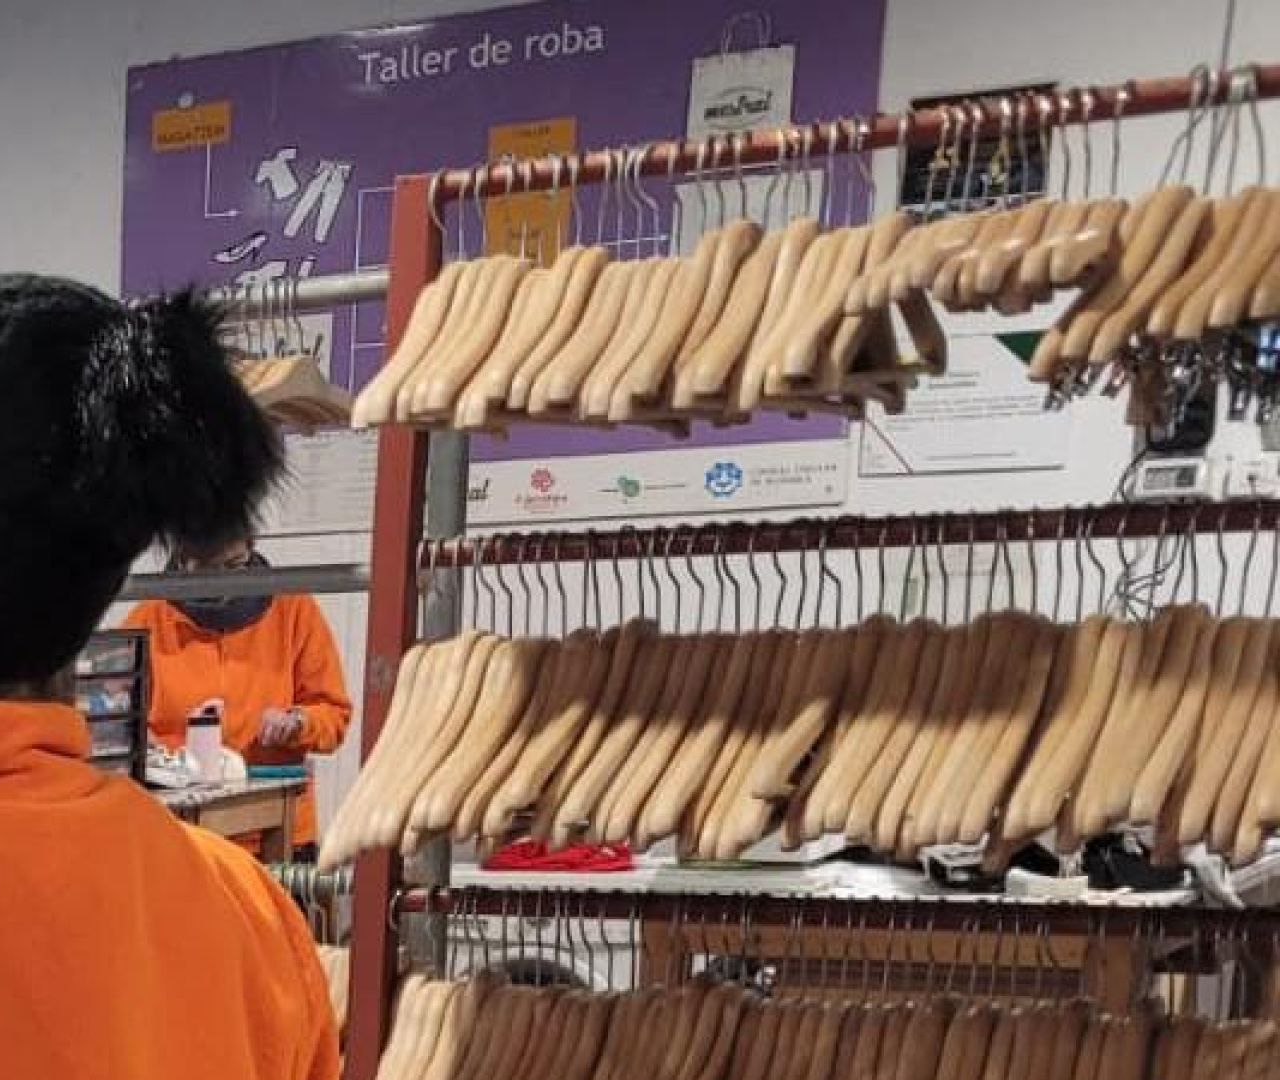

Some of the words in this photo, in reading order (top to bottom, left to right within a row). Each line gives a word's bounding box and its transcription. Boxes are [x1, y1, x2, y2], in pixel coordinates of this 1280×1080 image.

[358, 44, 458, 85] Taller
[469, 33, 513, 69] de
[524, 22, 606, 60] roba
